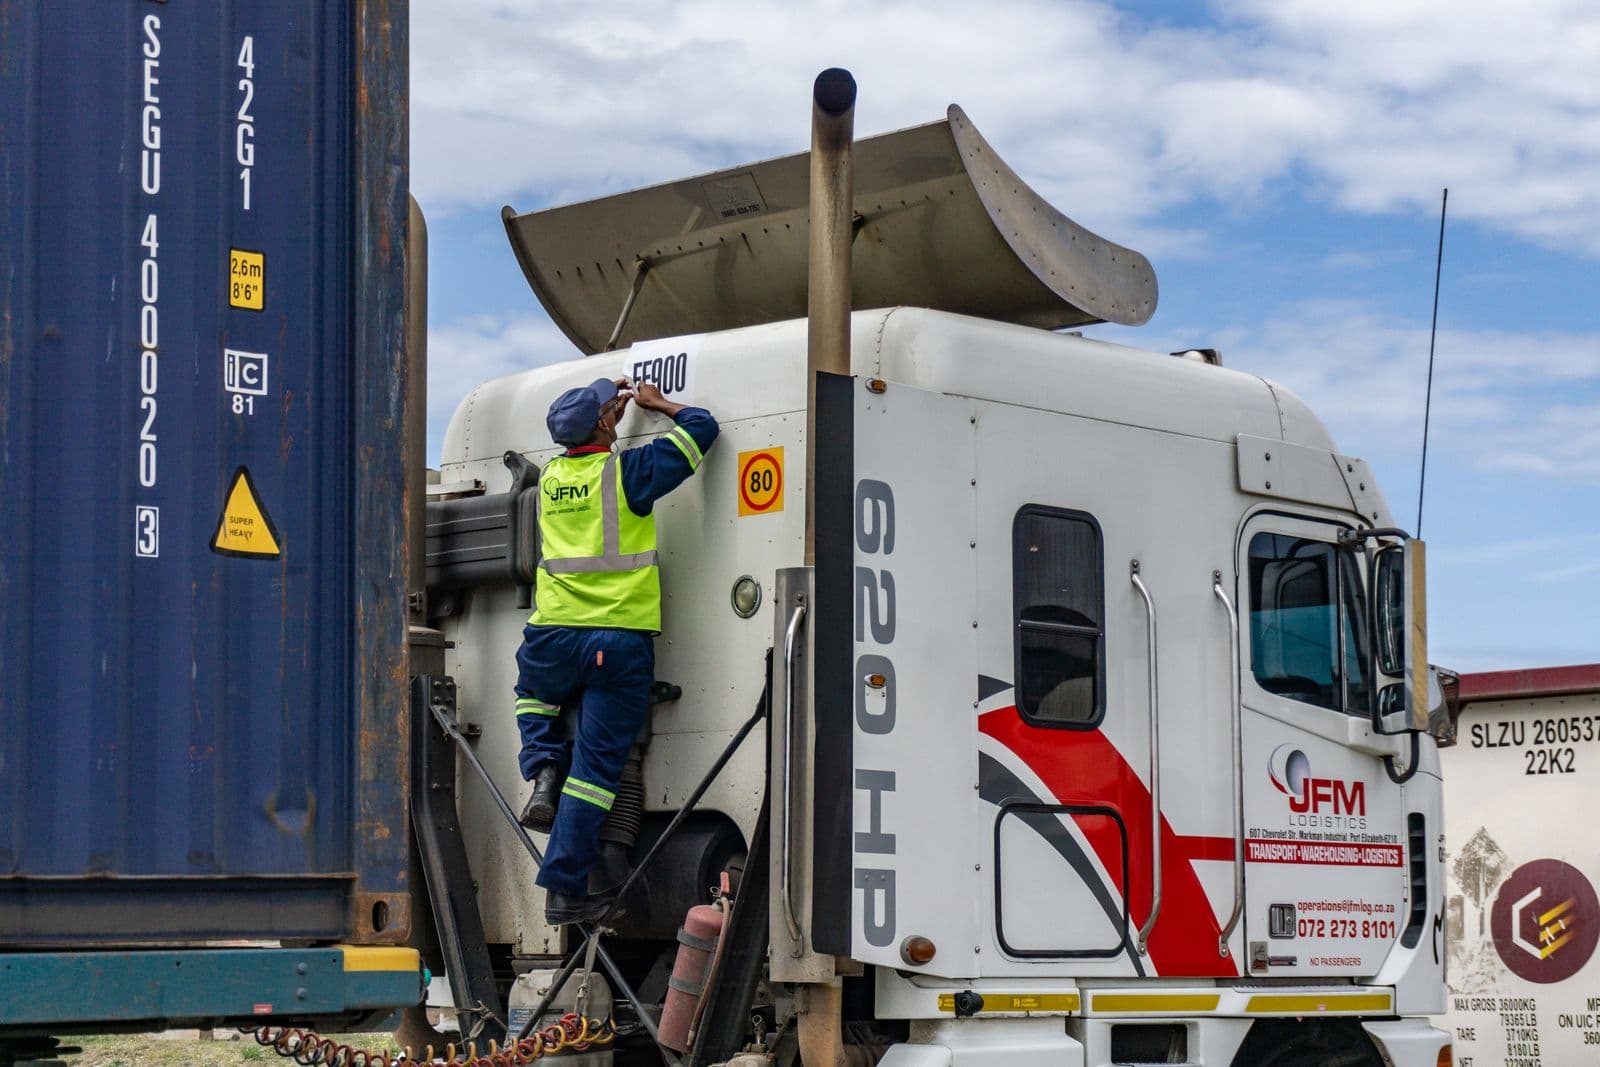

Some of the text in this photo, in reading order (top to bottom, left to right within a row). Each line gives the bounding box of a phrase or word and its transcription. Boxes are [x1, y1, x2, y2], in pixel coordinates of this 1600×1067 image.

[236, 36, 255, 210] 42G1
[139, 14, 161, 554] SEGU 400020 3
[232, 395, 254, 415] 81
[750, 469, 773, 493] 80
[551, 484, 588, 501] JFM
[229, 516, 254, 526] SUPER
[229, 529, 254, 539] HEAVY
[855, 478, 896, 948] 620 HP
[1471, 721, 1525, 749] SLZU
[1525, 748, 1576, 776] 22K2
[1289, 777, 1366, 817] JFM
[1289, 814, 1367, 830] LOGISTICS
[1297, 898, 1395, 916] operations@jfmlog.co.za
[1298, 919, 1396, 939] 072 273 8101
[1309, 957, 1361, 967] NO PASSENGERS
[1454, 998, 1470, 1011] MAX
[1471, 998, 1496, 1012] GROSS
[1558, 1014, 1574, 1028] ON
[1576, 1014, 1593, 1028] UIC
[1456, 1028, 1476, 1041] TARE
[1459, 1057, 1473, 1067] NET
